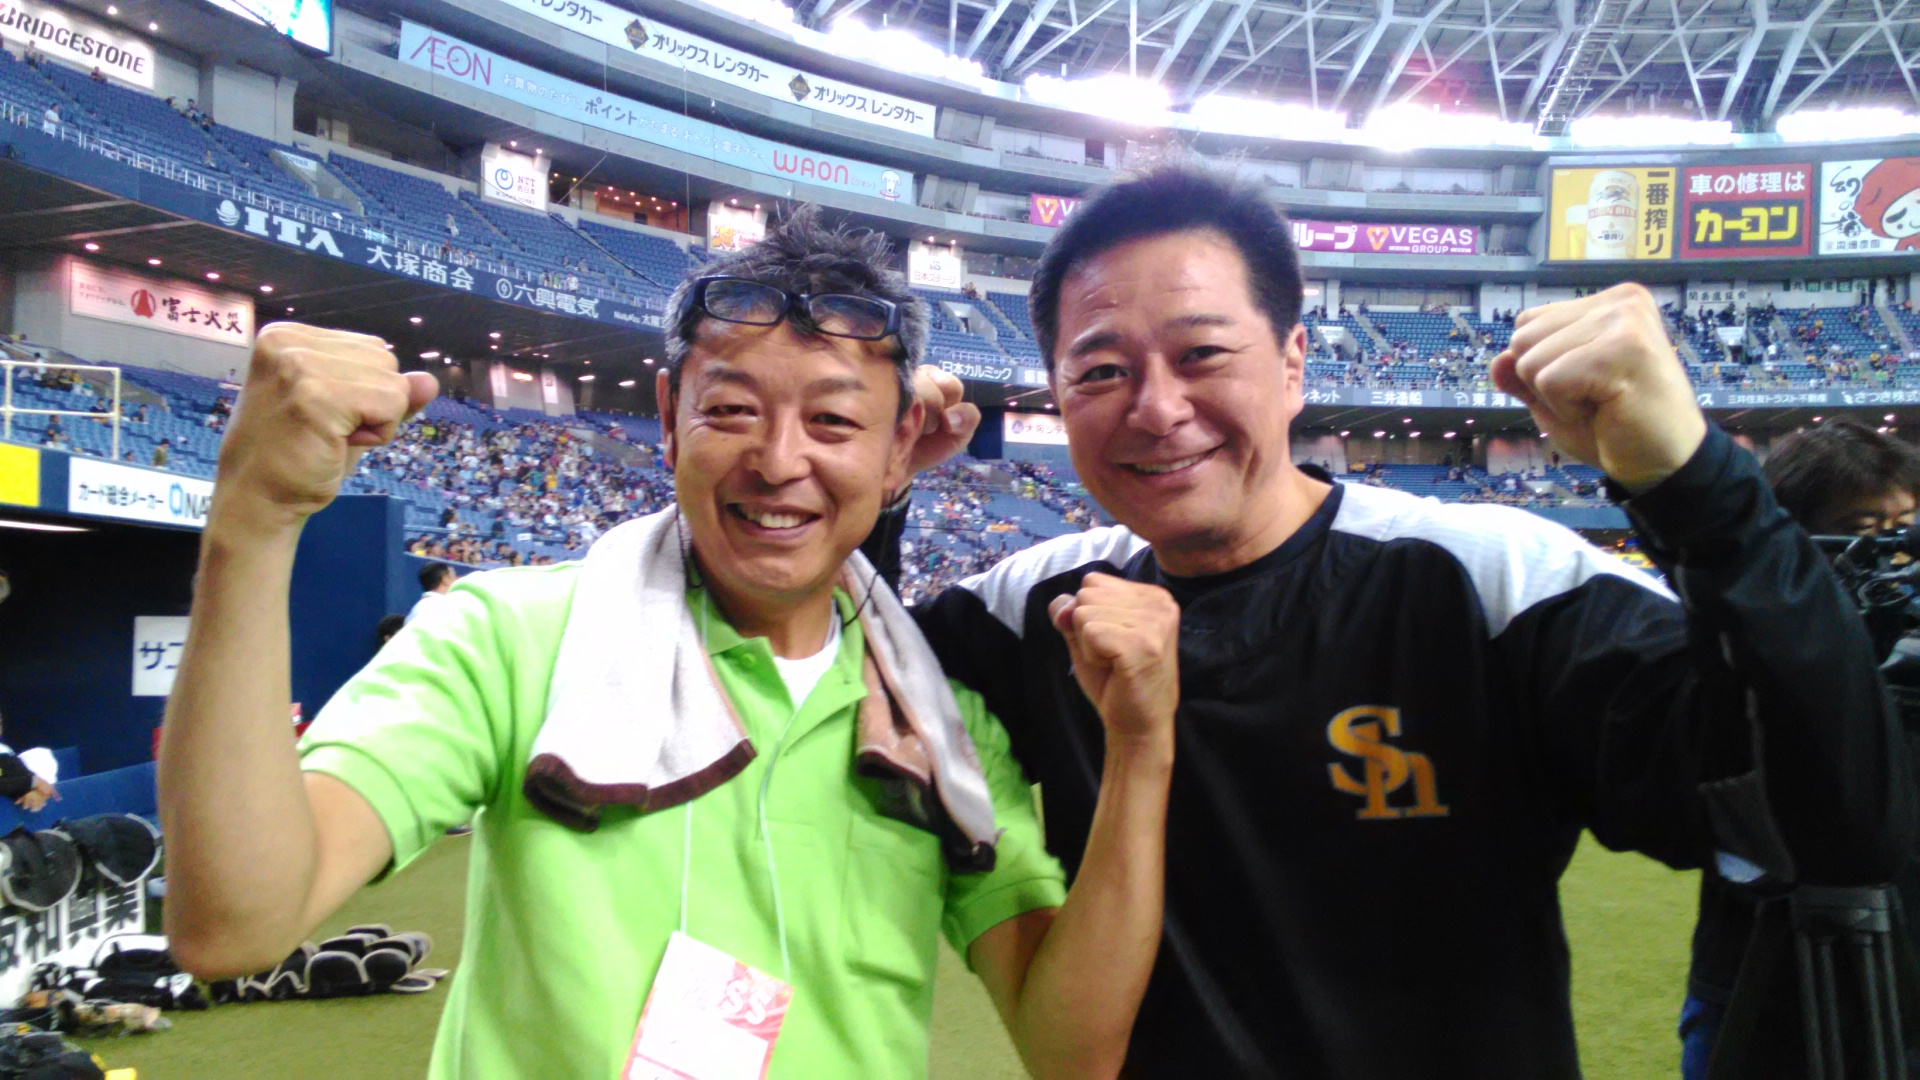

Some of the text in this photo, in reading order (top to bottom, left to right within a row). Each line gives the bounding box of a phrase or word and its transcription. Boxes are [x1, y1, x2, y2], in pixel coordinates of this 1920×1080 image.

[0, 4, 146, 75] BRIDGESTONE
[517, 175, 536, 188] NTT
[772, 149, 849, 185] WAON
[1689, 170, 1806, 196] 車の修理は
[1644, 170, 1671, 256] 一番搾り
[1694, 205, 1799, 243] カーコン
[1390, 226, 1473, 245] VEGAS
[1411, 245, 1449, 254] GROUP
[366, 245, 475, 291] 大塚商会
[162, 297, 243, 334] 富士火災
[513, 281, 599, 319] 六興電気
[942, 360, 1012, 380] 日本カルミック
[1371, 390, 1423, 406] 三井造船
